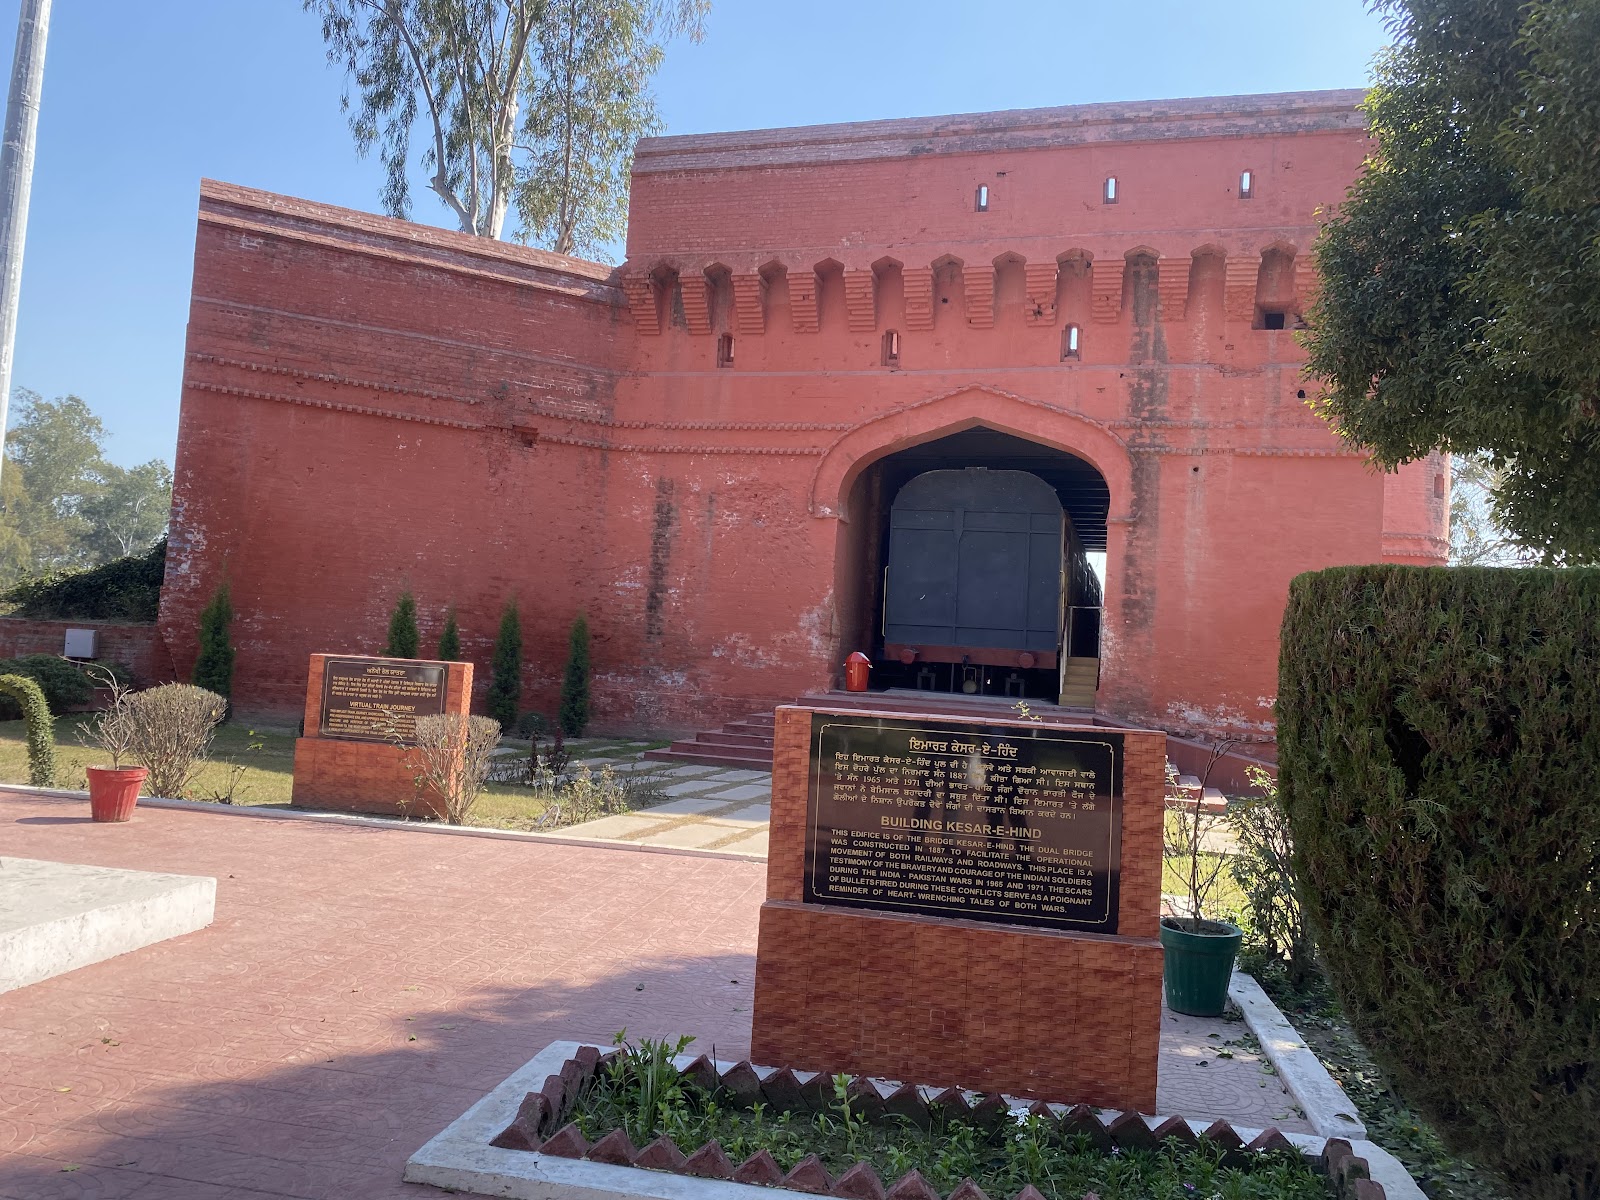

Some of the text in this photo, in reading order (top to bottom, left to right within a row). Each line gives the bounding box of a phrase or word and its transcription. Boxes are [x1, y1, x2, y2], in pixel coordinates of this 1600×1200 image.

[950, 772, 968, 780] 1887
[881, 816, 1042, 839] BUILDING KESAR-E-HIND
[851, 830, 880, 838] EDIFICE
[924, 836, 954, 845] BRIDGE
[956, 840, 1016, 850] KESAR-E-HIND.
[1038, 846, 1060, 854] DUAL
[1063, 848, 1093, 858] BRIDGE
[853, 840, 910, 850] CONSTRUCTED
[966, 850, 1010, 860] FACILITATE
[1036, 856, 1092, 866] OPERATIONAL
[830, 848, 873, 858] MOVEMENT
[890, 852, 910, 860] BOTH
[914, 854, 954, 864] RAILWAYS
[978, 860, 1024, 870] ROADWAYS.
[1028, 864, 1046, 872] THIS
[1048, 866, 1074, 875] PLACE
[830, 857, 872, 866] TESTIMONY
[901, 863, 938, 872] BRAVERY
[954, 868, 993, 877] COURAGE
[1023, 874, 1050, 882] INDIAN
[1052, 876, 1092, 886] SOLDIERS
[830, 866, 858, 874] DURING
[908, 873, 946, 882] PAKISTAN
[950, 876, 972, 885] WARS
[1006, 882, 1024, 890] AND
[1065, 887, 1092, 896] SCARS
[840, 876, 874, 886] BULLETS
[875, 880, 898, 888] FIRED
[900, 882, 928, 890] DURING
[930, 884, 956, 893] THESE
[958, 886, 1002, 897] CONFLICTS
[1004, 892, 1030, 900] SERVE
[1050, 896, 1092, 906] POIGNANT
[829, 885, 868, 894] REMINDER
[918, 894, 966, 904] WRENCHING
[970, 898, 994, 906] TALES
[1015, 902, 1036, 910] BOTH
[1042, 904, 1067, 913] WARS.
